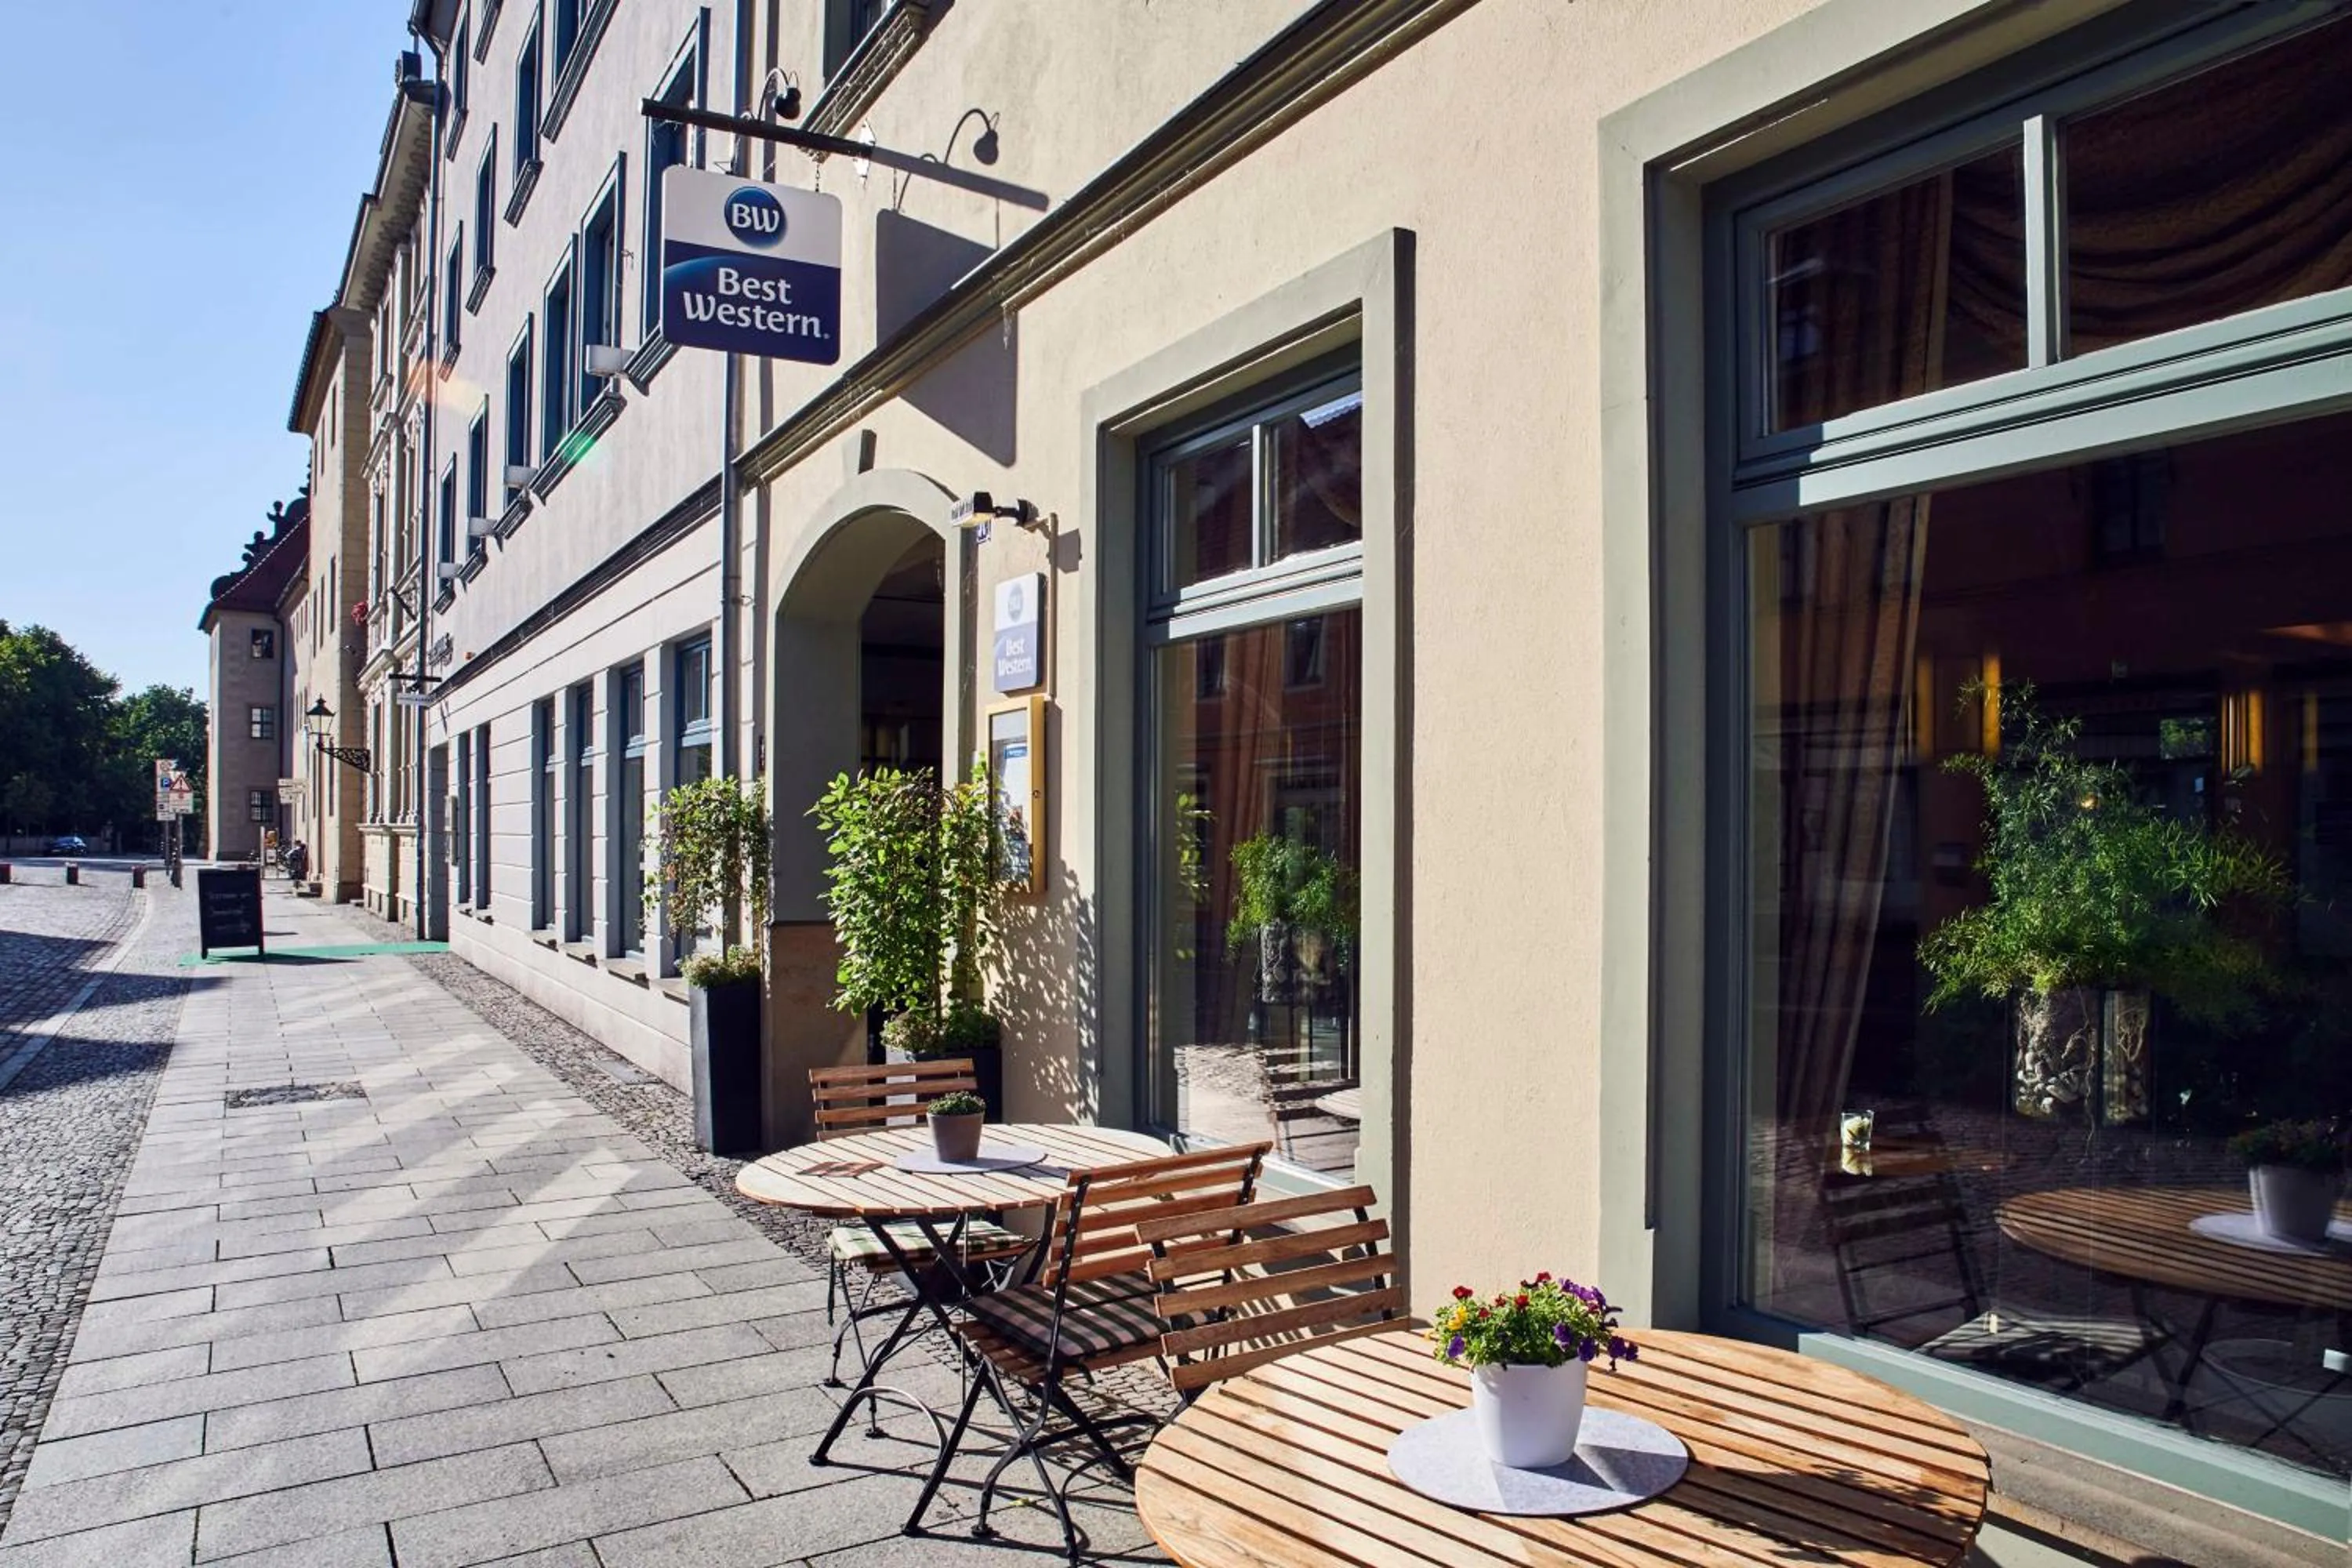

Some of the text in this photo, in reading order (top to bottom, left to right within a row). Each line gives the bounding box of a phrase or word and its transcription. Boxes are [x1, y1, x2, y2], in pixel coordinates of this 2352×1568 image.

[731, 203, 780, 233] BW
[717, 267, 791, 304] Best
[683, 291, 822, 338] Western
[1006, 638, 1025, 657] Best
